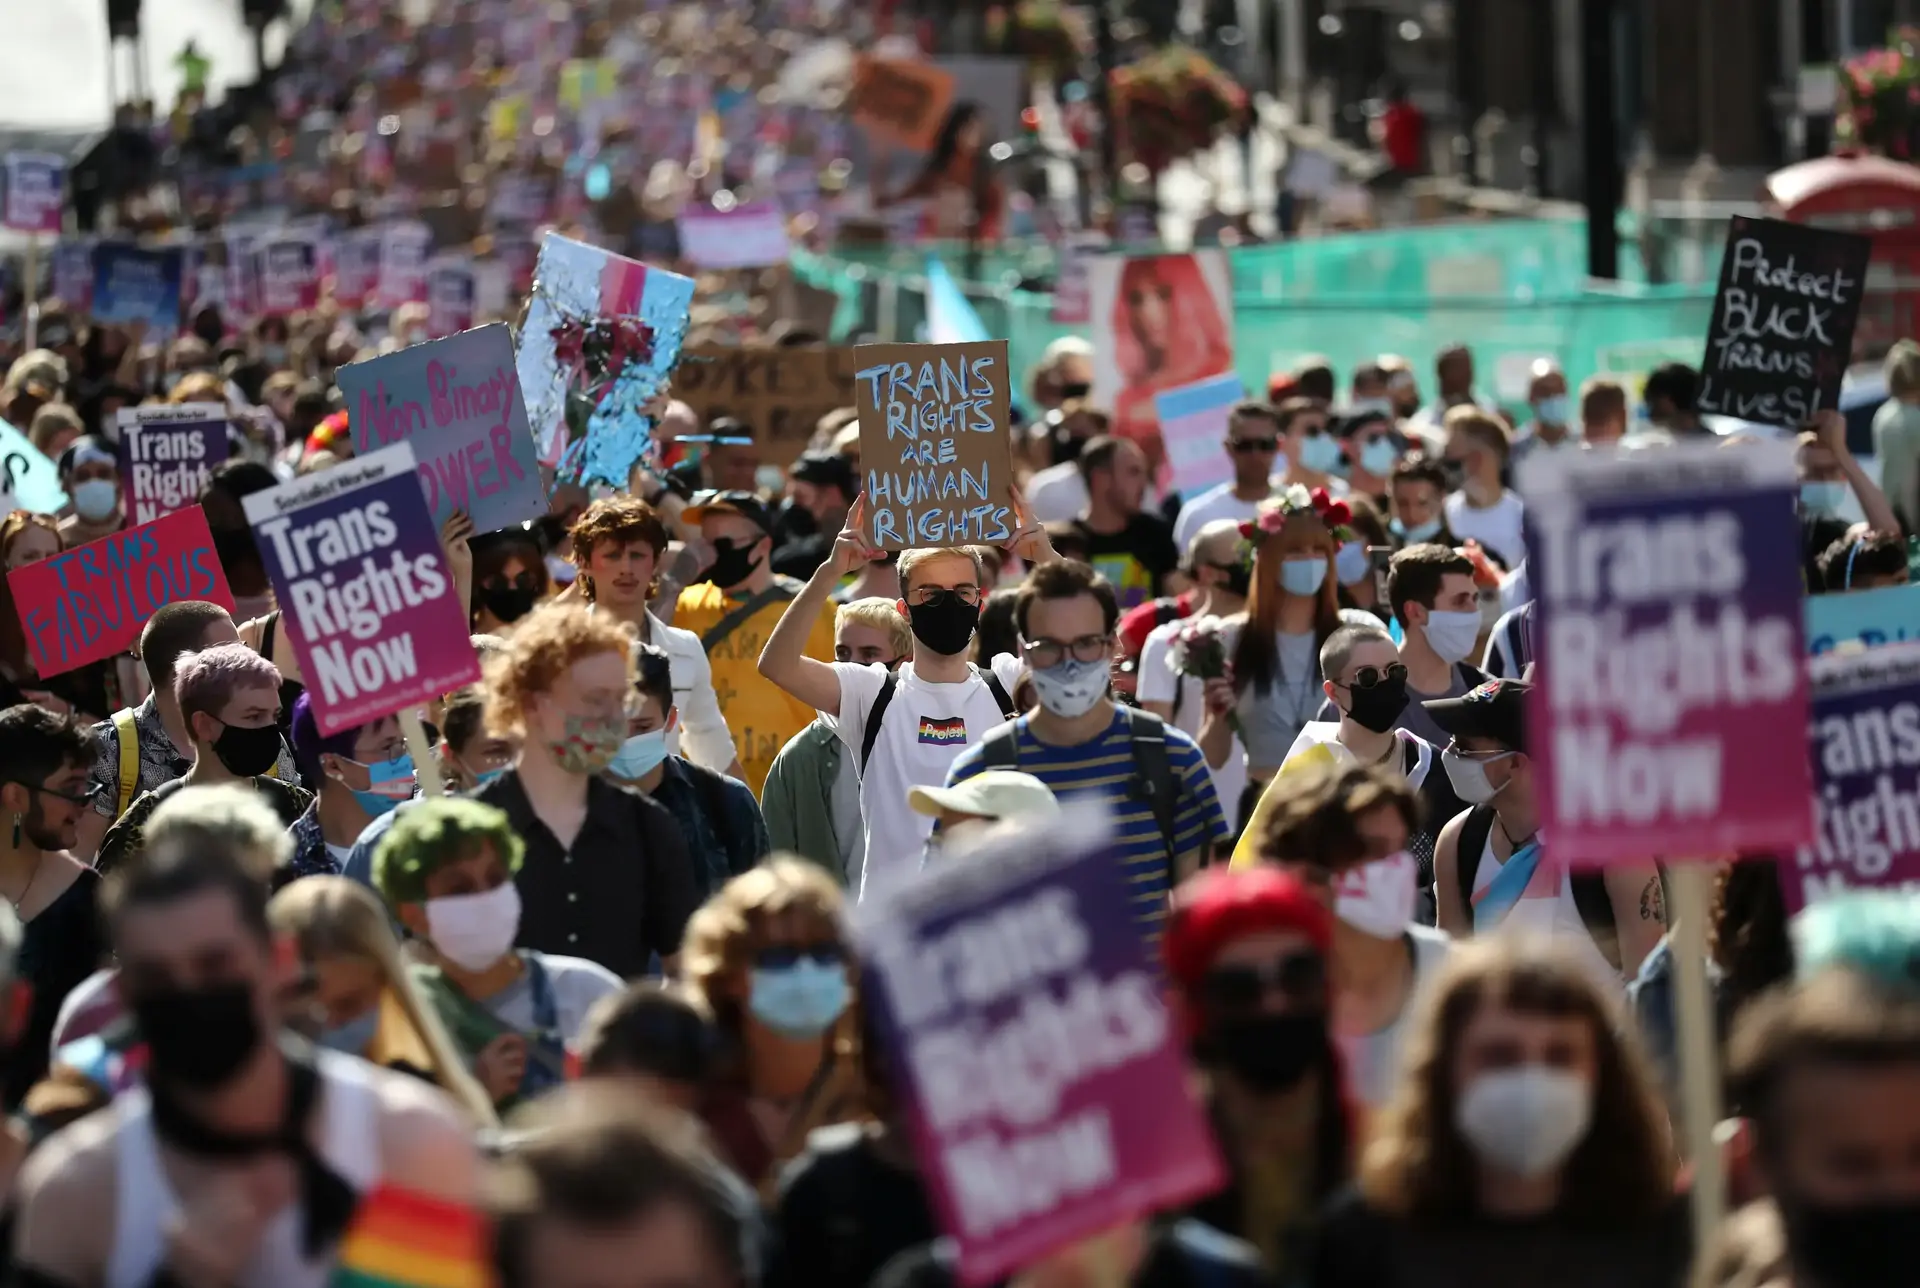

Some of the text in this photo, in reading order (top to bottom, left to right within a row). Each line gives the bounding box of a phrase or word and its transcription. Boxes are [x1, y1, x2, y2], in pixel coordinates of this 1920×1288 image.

[359, 357, 518, 451] Non Binary
[855, 354, 995, 412] TRANS
[886, 399, 996, 440] RIGHTS
[123, 423, 206, 462] Trans
[417, 423, 525, 517] OWER
[900, 438, 958, 467] ARE
[132, 460, 207, 507] Right
[868, 460, 989, 508] HUMAN
[47, 526, 159, 589] TRANS
[259, 500, 398, 580] Trans
[873, 502, 1011, 547] RIGHTS
[1522, 494, 1746, 602] Trans
[26, 547, 216, 664] FABULOUS
[289, 550, 447, 643] Rights
[310, 631, 419, 706] Now
[1548, 604, 1796, 733] Rights
[924, 723, 964, 740] Protest
[1807, 703, 1920, 776] ans
[1552, 724, 1724, 826] Now
